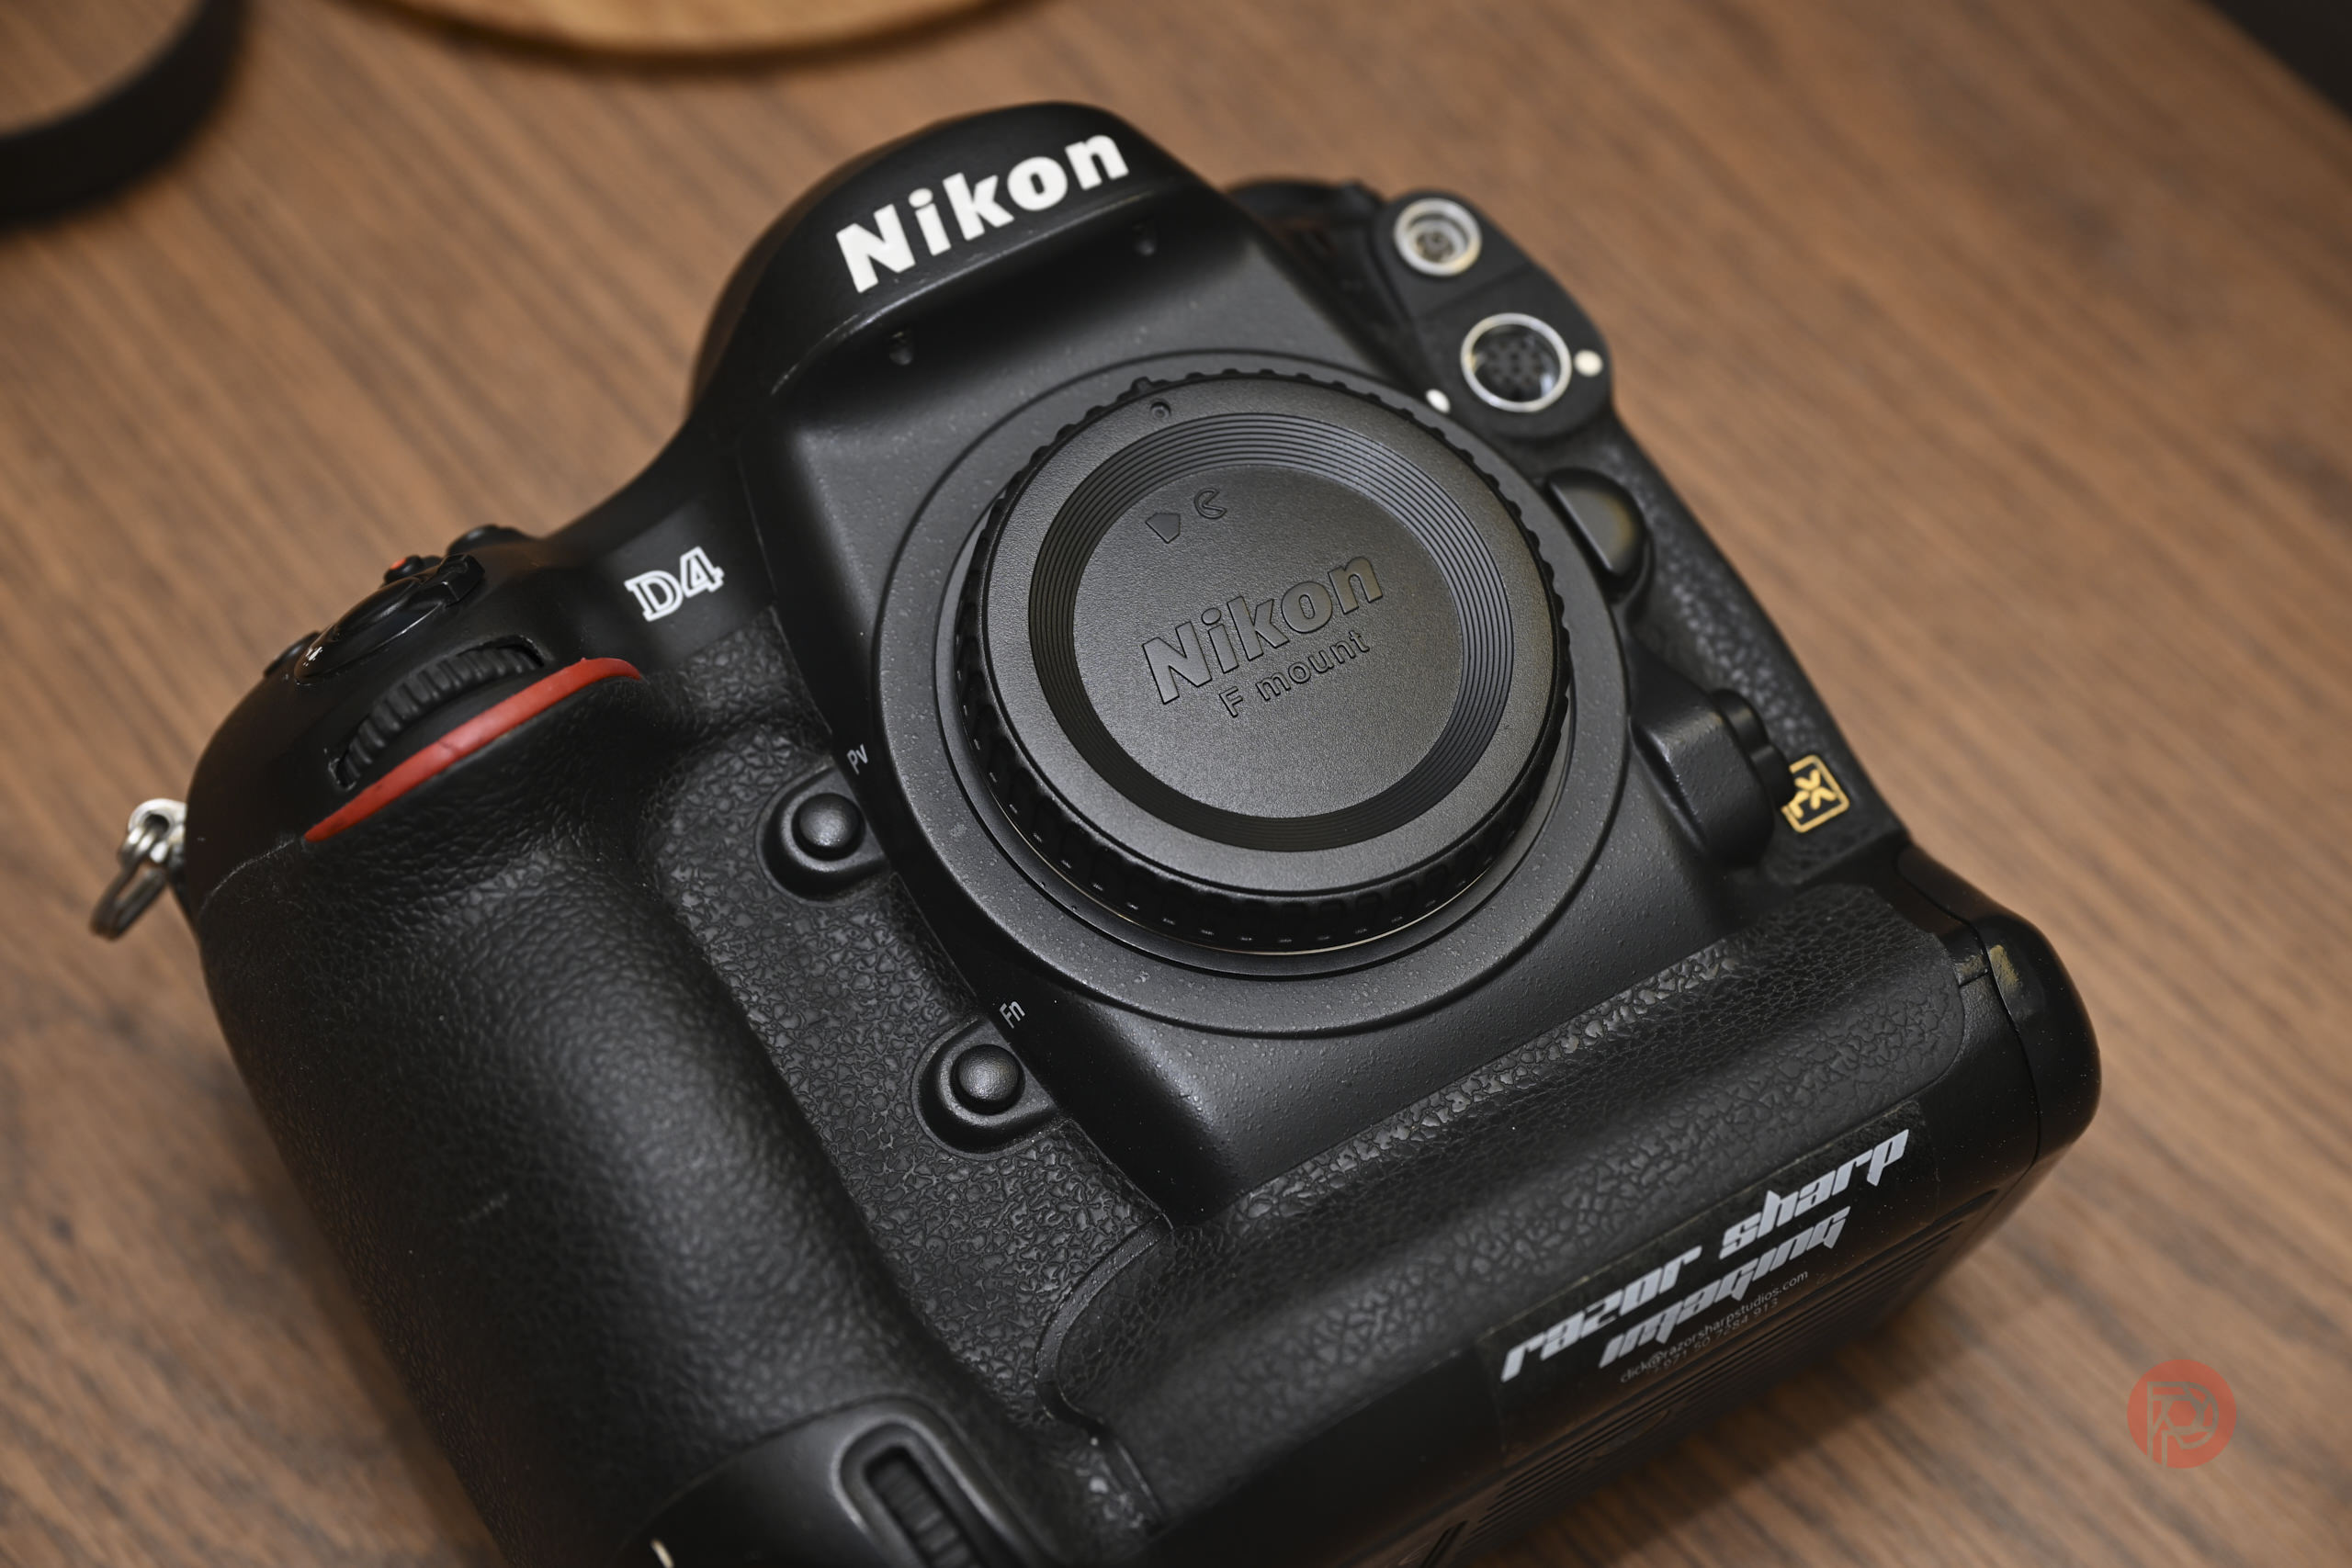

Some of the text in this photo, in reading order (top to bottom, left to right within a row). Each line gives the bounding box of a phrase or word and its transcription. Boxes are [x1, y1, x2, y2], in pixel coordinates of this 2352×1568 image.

[836, 135, 1129, 293] Nikon
[624, 546, 725, 622] D4
[1142, 557, 1383, 705] Nikon
[1218, 629, 1371, 718] F mount
[999, 1000, 1026, 1029] Fn
[1501, 1129, 1909, 1382] razor sharp
